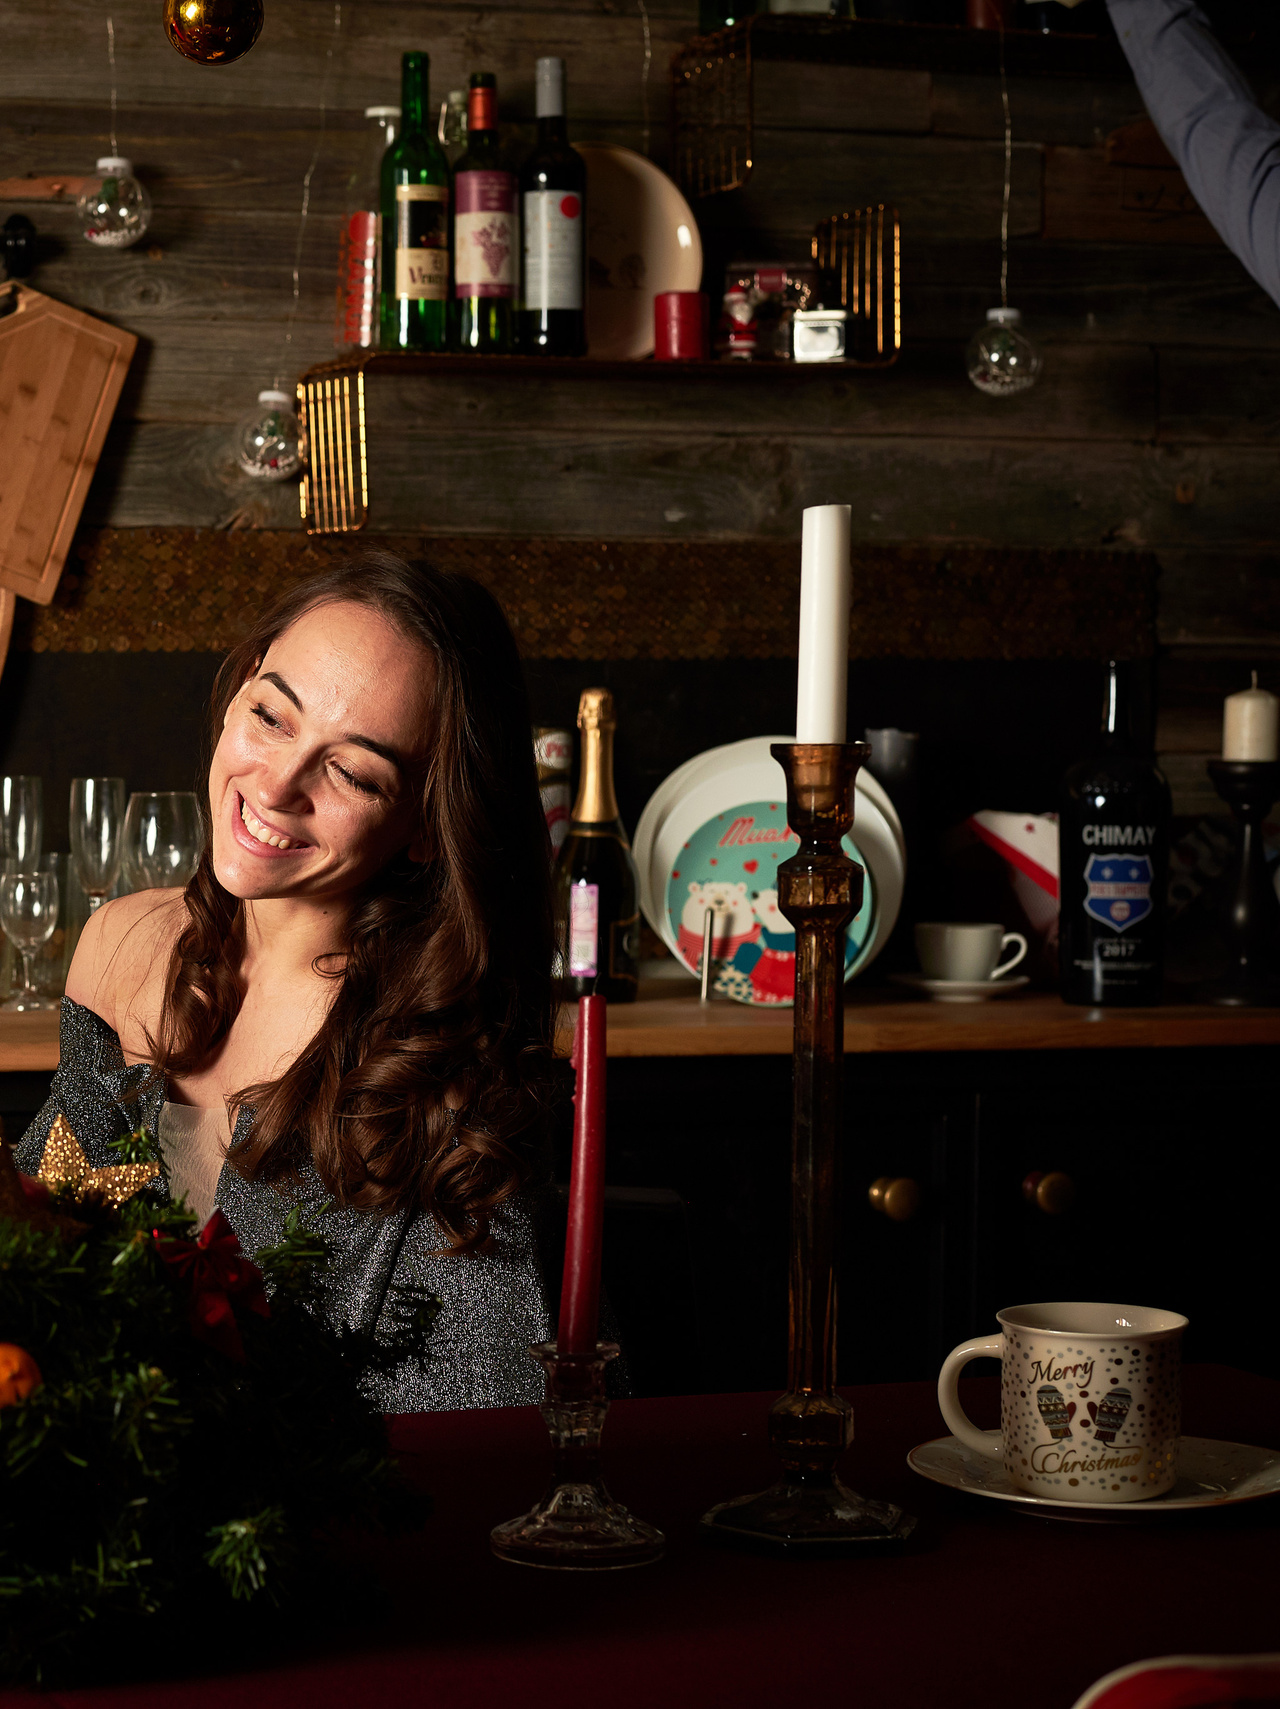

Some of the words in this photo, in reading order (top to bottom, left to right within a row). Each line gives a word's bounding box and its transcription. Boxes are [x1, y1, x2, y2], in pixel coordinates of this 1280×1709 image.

[1081, 824, 1156, 847] CHIMAY
[1102, 943, 1136, 957] 2017
[1027, 1357, 1096, 1388] Merry
[1040, 1449, 1141, 1474] Christmas
